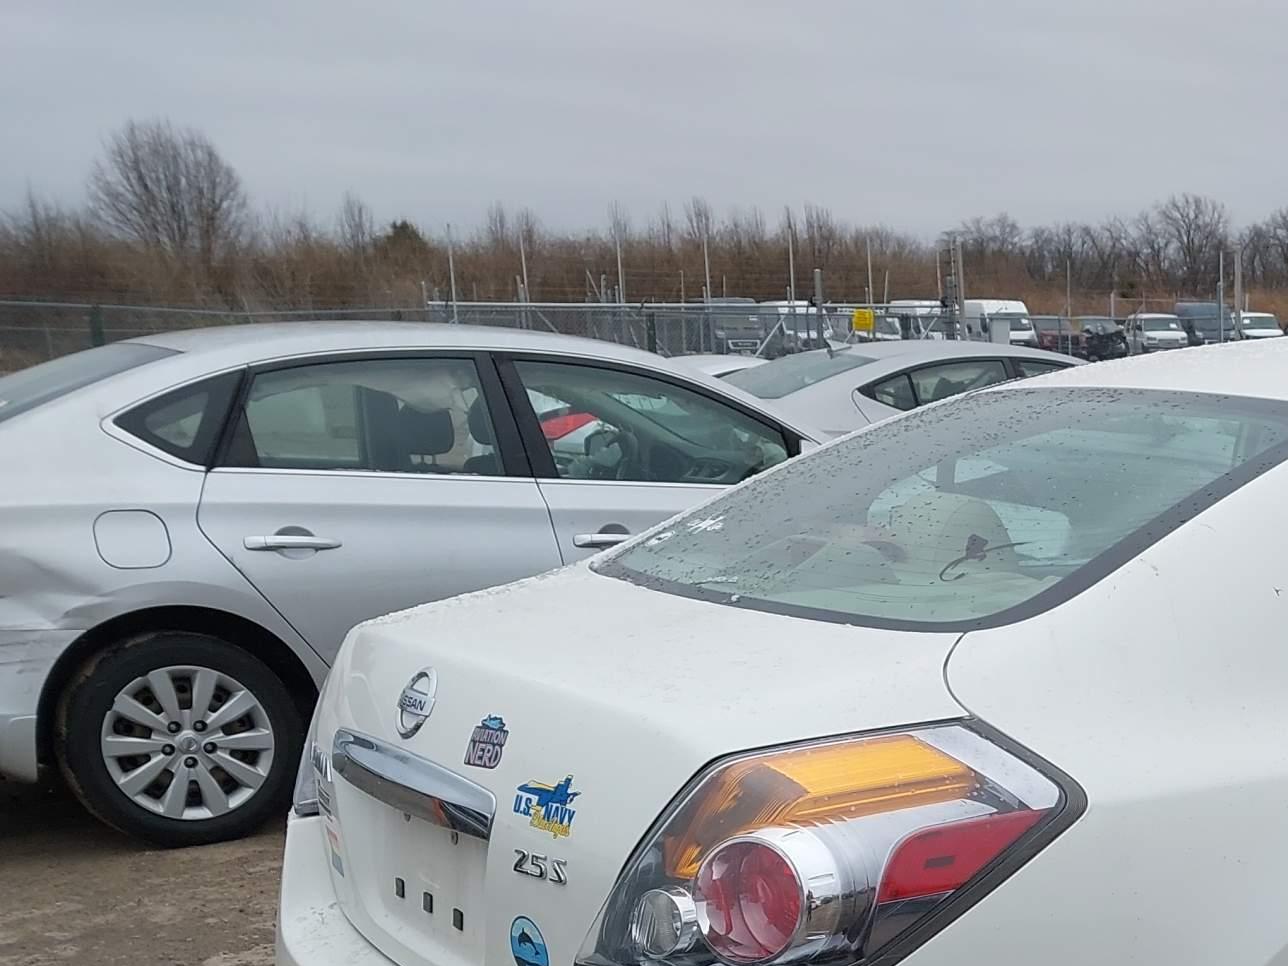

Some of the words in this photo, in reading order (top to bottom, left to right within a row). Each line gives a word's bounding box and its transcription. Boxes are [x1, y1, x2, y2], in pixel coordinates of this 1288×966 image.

[464, 741, 502, 768] NERD
[513, 793, 533, 817] U.S.
[543, 803, 577, 827] NAVY
